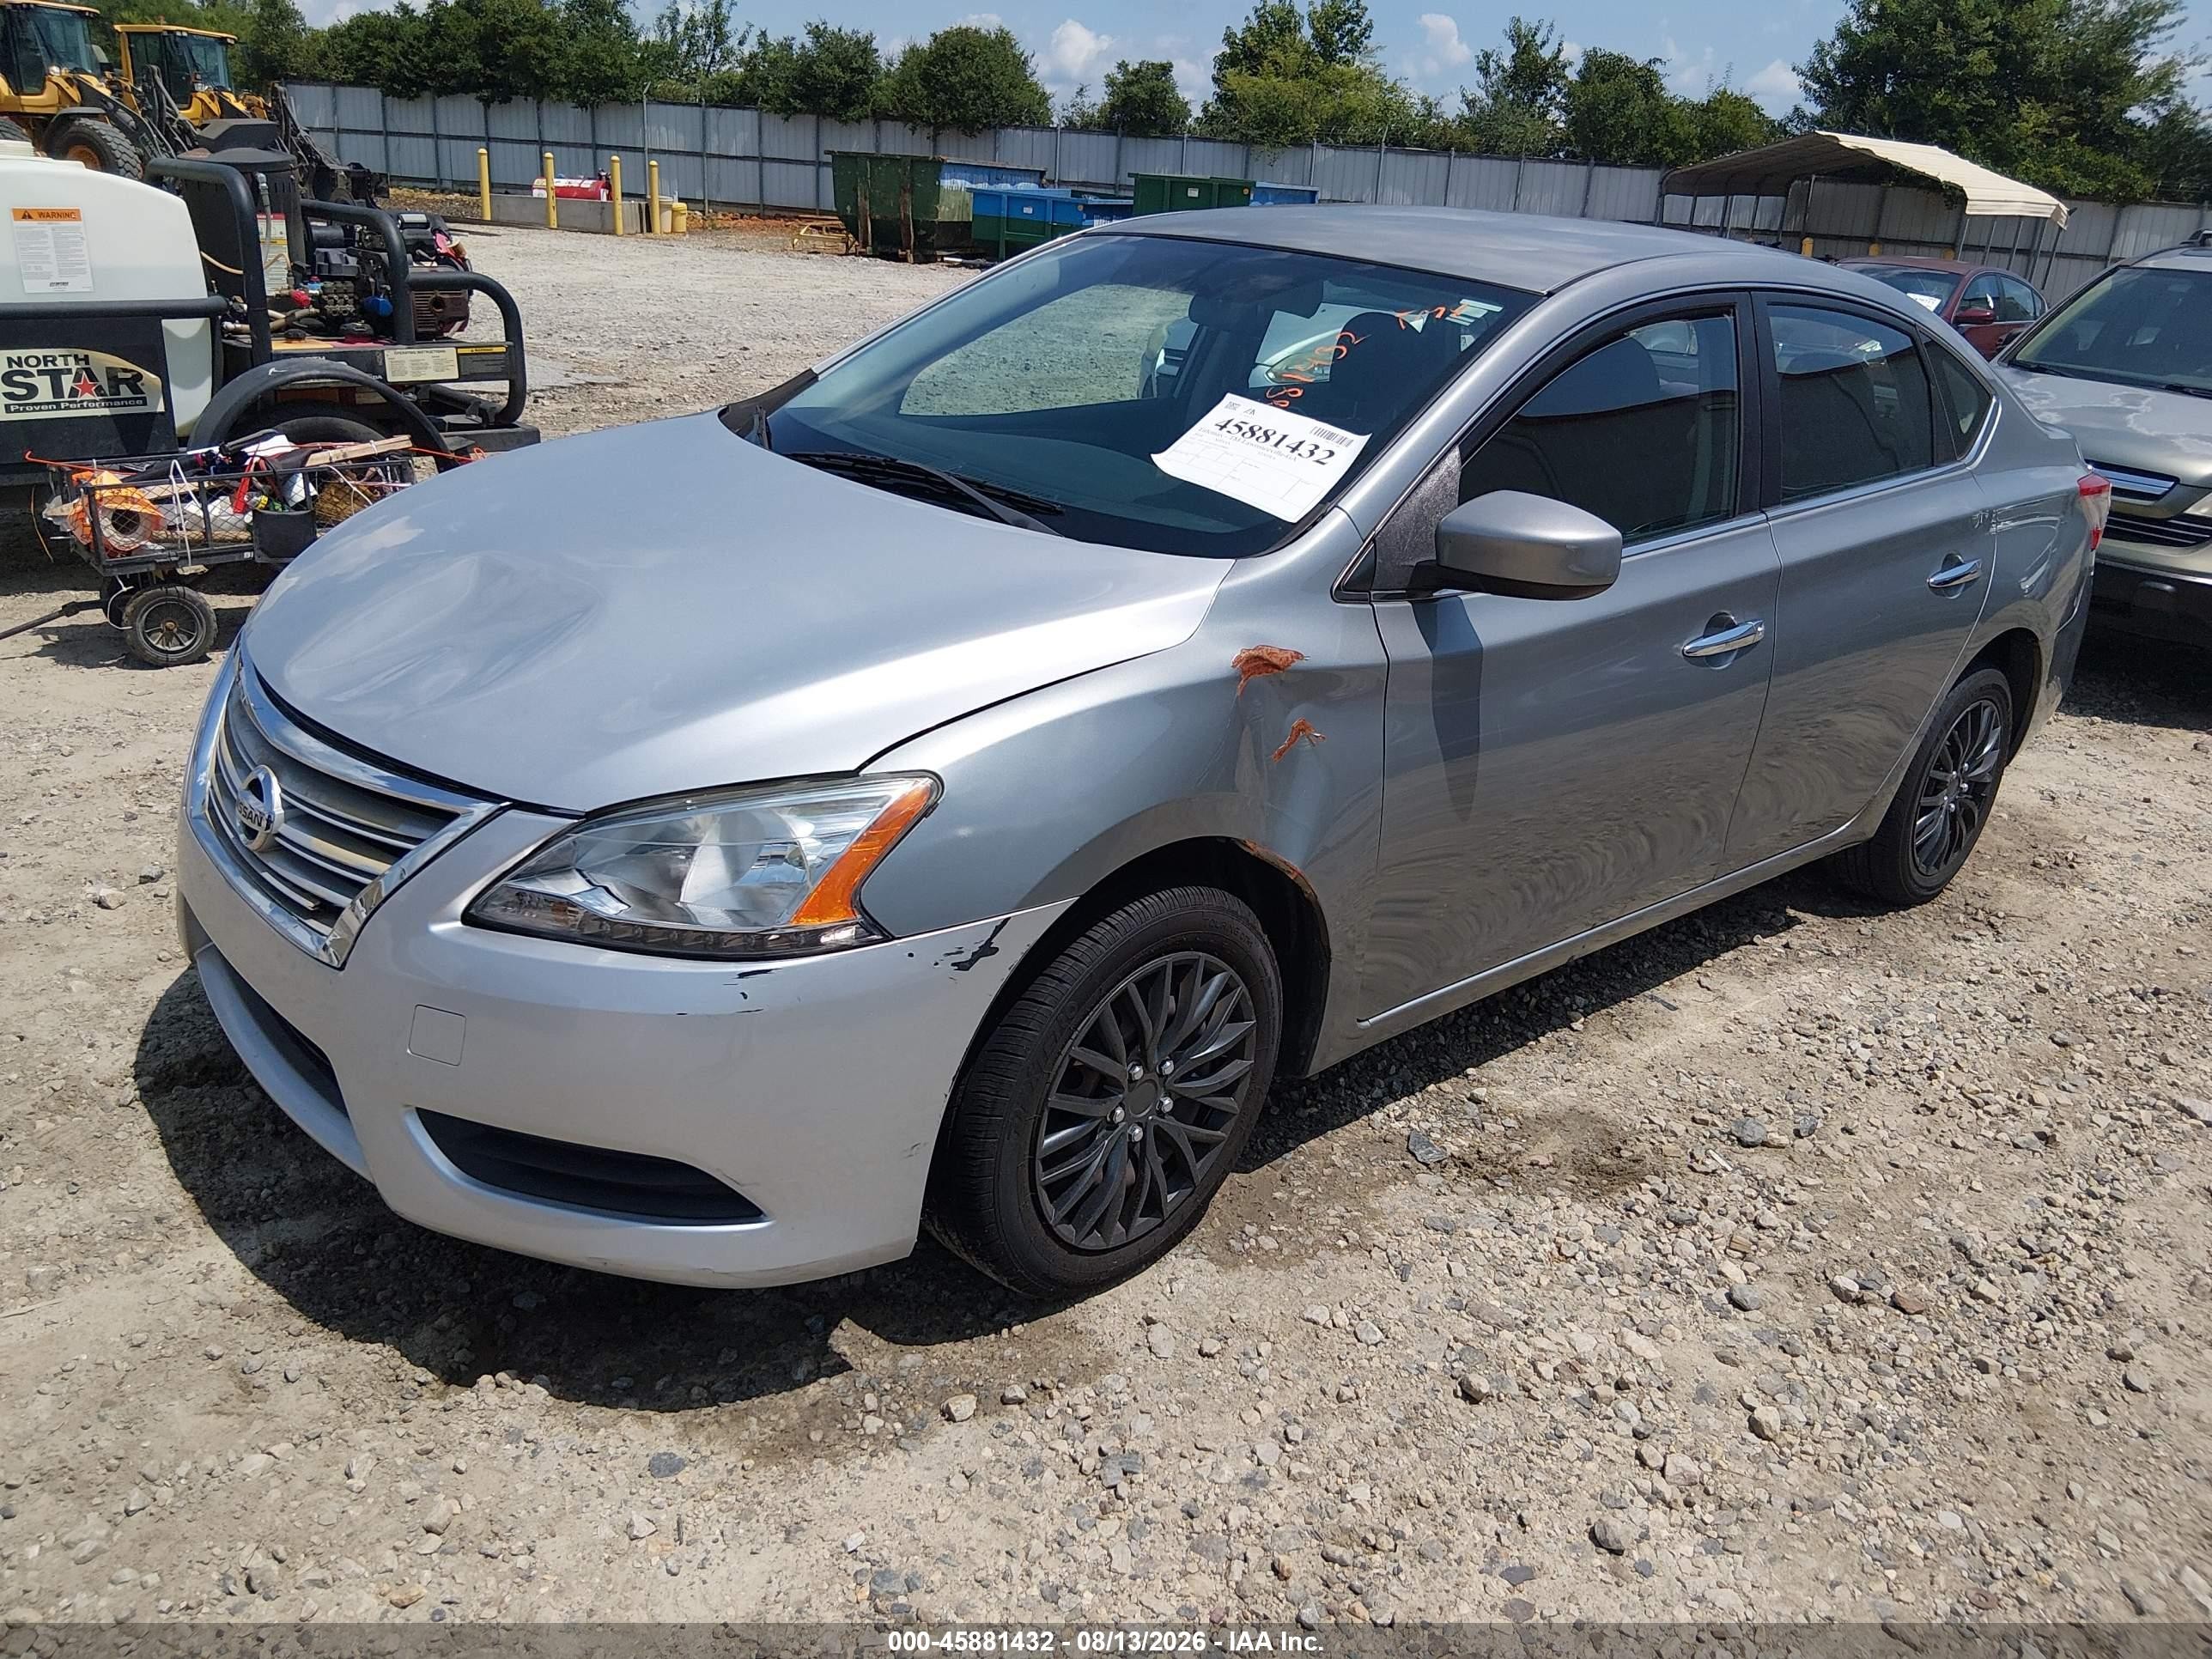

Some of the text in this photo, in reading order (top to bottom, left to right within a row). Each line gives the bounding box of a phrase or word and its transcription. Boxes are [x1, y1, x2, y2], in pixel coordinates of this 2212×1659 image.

[7, 354, 90, 368] NORTH
[1, 367, 146, 401] STAR
[10, 398, 143, 413] Proven Performance
[1214, 417, 1336, 465] 45881432
